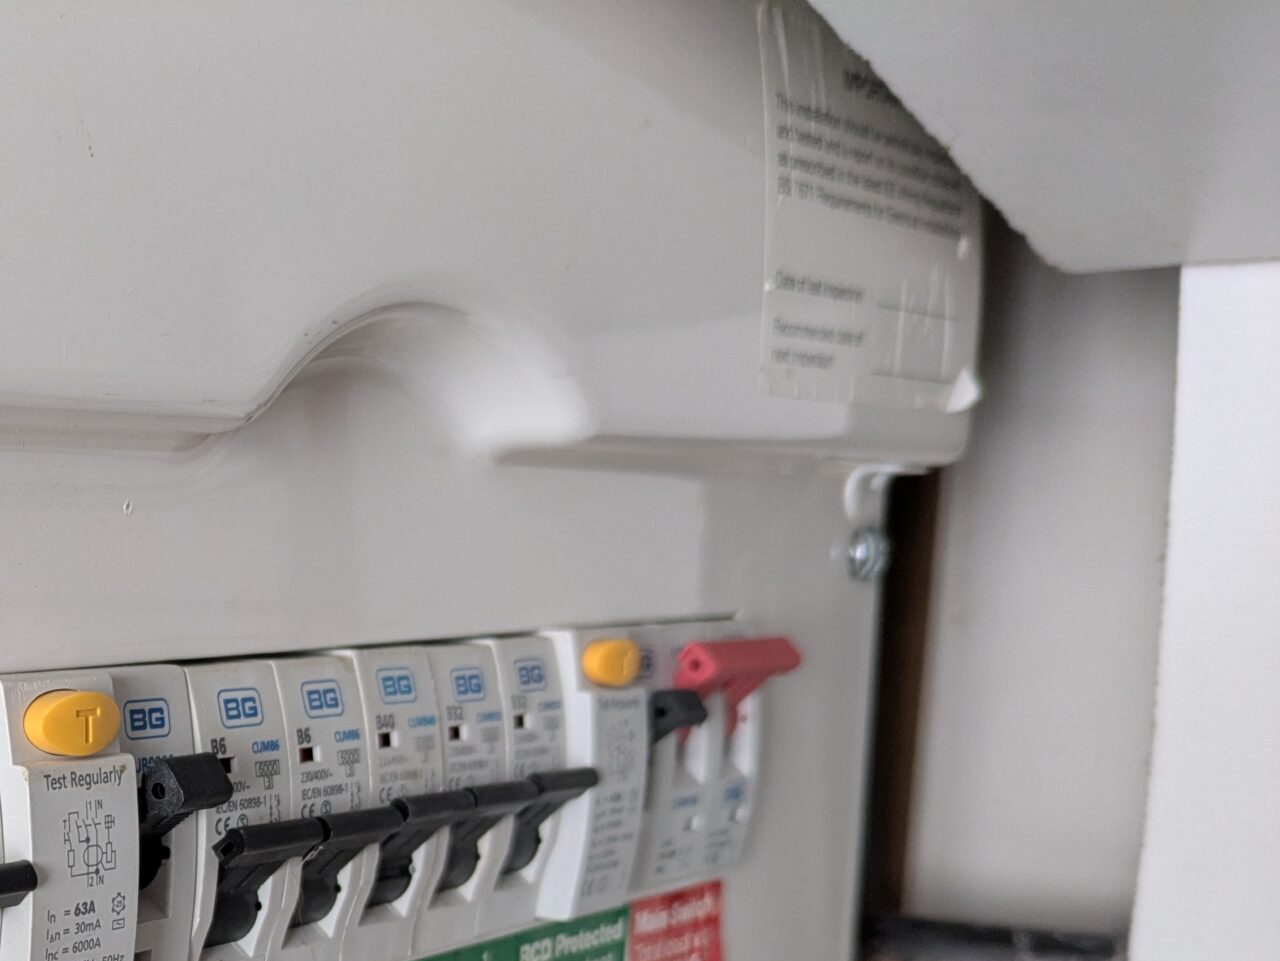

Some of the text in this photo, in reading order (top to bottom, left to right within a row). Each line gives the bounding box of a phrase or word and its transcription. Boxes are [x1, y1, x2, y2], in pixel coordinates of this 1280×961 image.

[380, 675, 413, 697] BG
[454, 673, 483, 696] BG
[222, 695, 259, 721] BG
[305, 687, 340, 710] BG
[74, 707, 102, 745] T
[128, 707, 166, 732] BG
[210, 736, 227, 755] B6
[296, 727, 312, 745] B6
[42, 773, 68, 792] Test
[70, 764, 124, 791] Regularly
[74, 900, 96, 918] 63A
[74, 918, 102, 935] 30mA
[554, 914, 626, 957] Protected
[72, 936, 102, 954] 6000A
